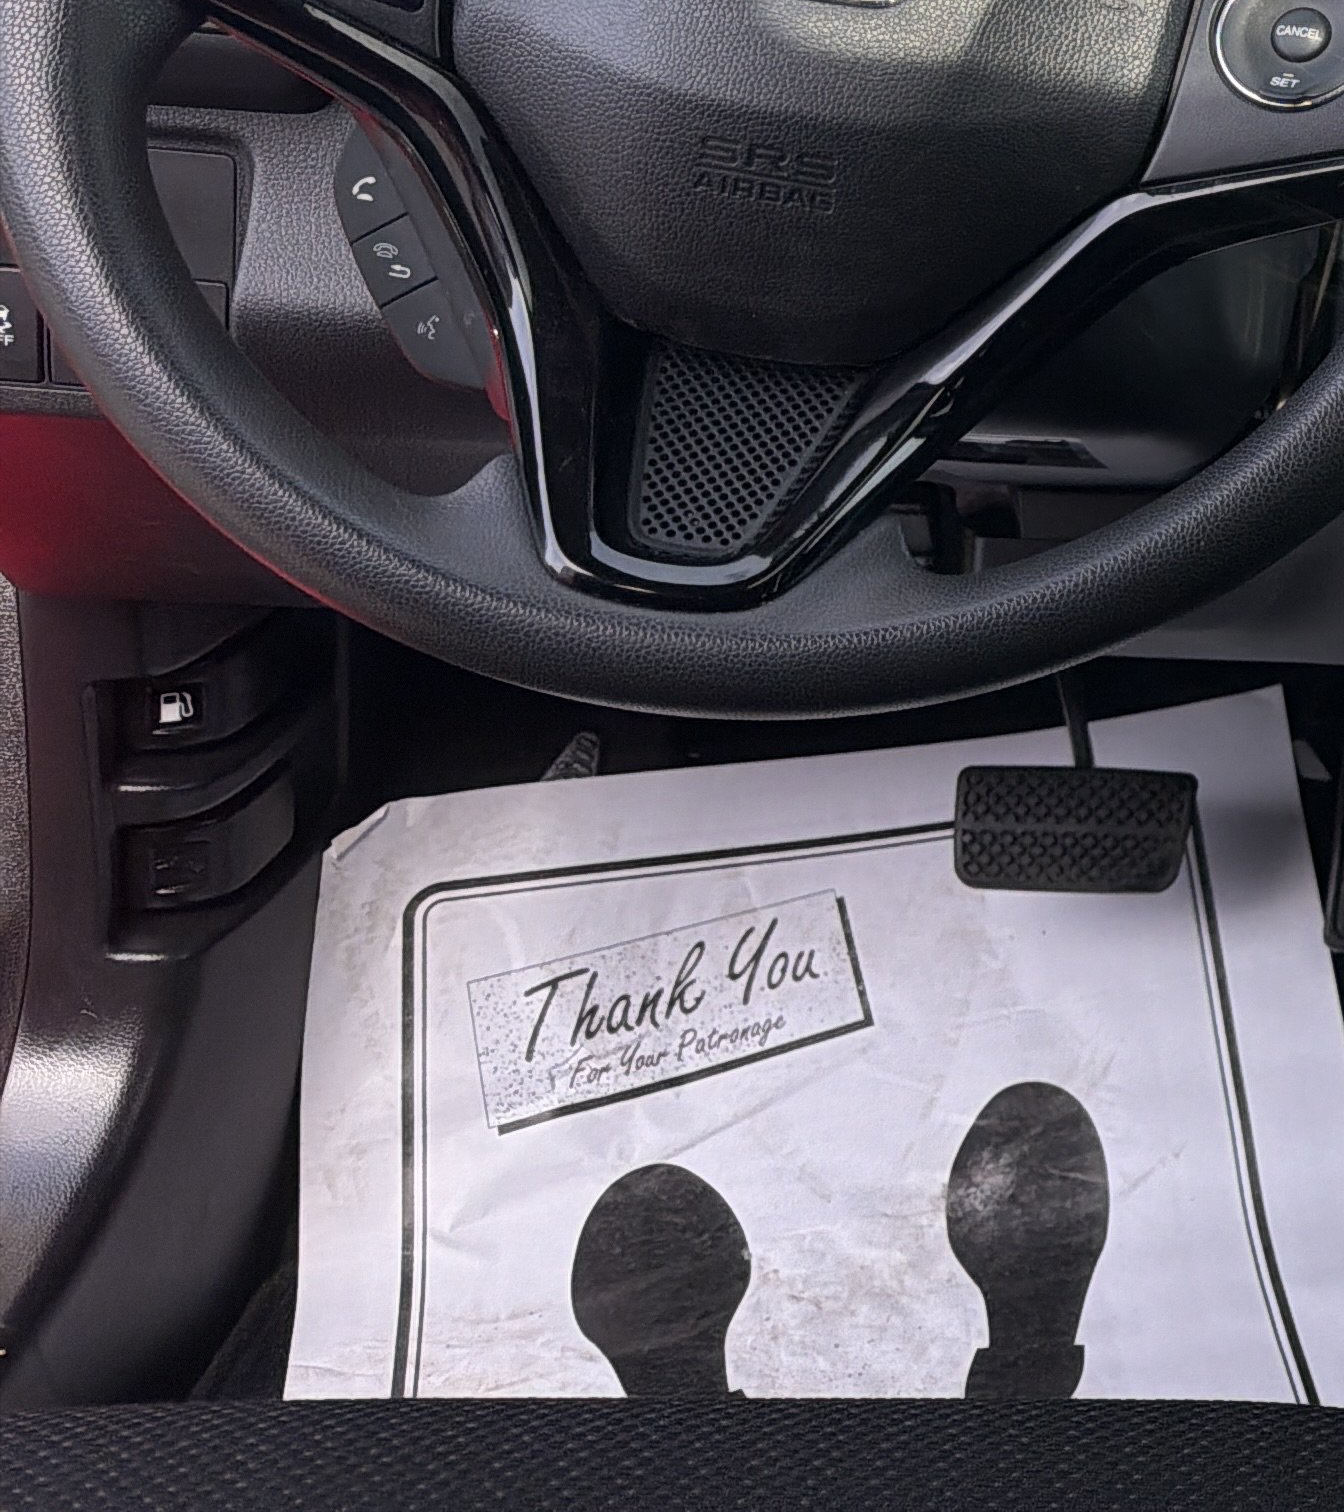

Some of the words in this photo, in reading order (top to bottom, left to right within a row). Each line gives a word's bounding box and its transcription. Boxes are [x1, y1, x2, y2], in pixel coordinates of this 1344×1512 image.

[1275, 24, 1323, 40] CANCEL
[1269, 75, 1300, 88] SET
[698, 136, 839, 186] SRS
[694, 176, 837, 216] AIRBAG
[523, 940, 707, 1062] Thank
[727, 918, 820, 1006] You
[569, 1054, 611, 1088] For
[620, 1044, 669, 1076] Your
[677, 1016, 787, 1062] Patronage
